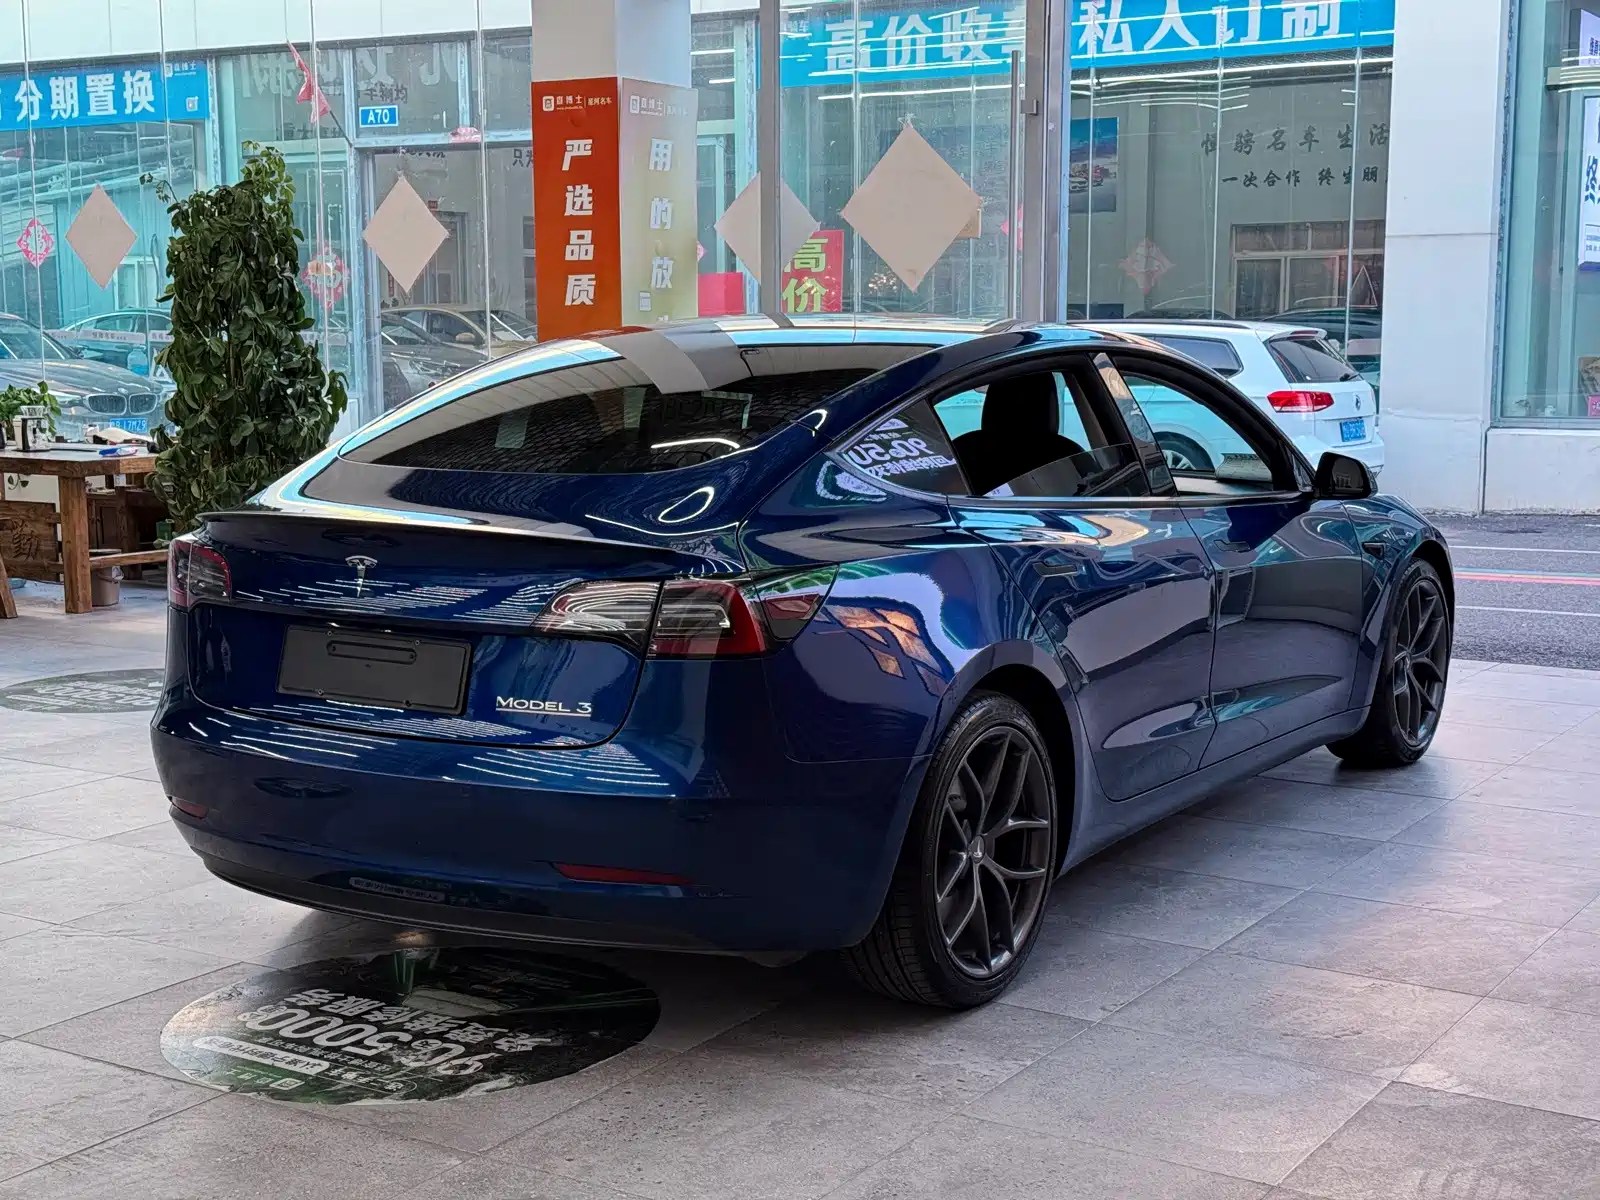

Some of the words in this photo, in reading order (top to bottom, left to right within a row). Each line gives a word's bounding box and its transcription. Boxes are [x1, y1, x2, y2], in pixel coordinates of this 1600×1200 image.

[15, 70, 155, 122] 分期置换
[368, 109, 390, 124] A70
[1222, 169, 1300, 188] 一次合作
[1318, 165, 1388, 187] 终生朋
[562, 138, 596, 306] 严选品质
[783, 238, 828, 312] 高价
[496, 695, 571, 712] MODEL
[576, 702, 592, 713] 3
